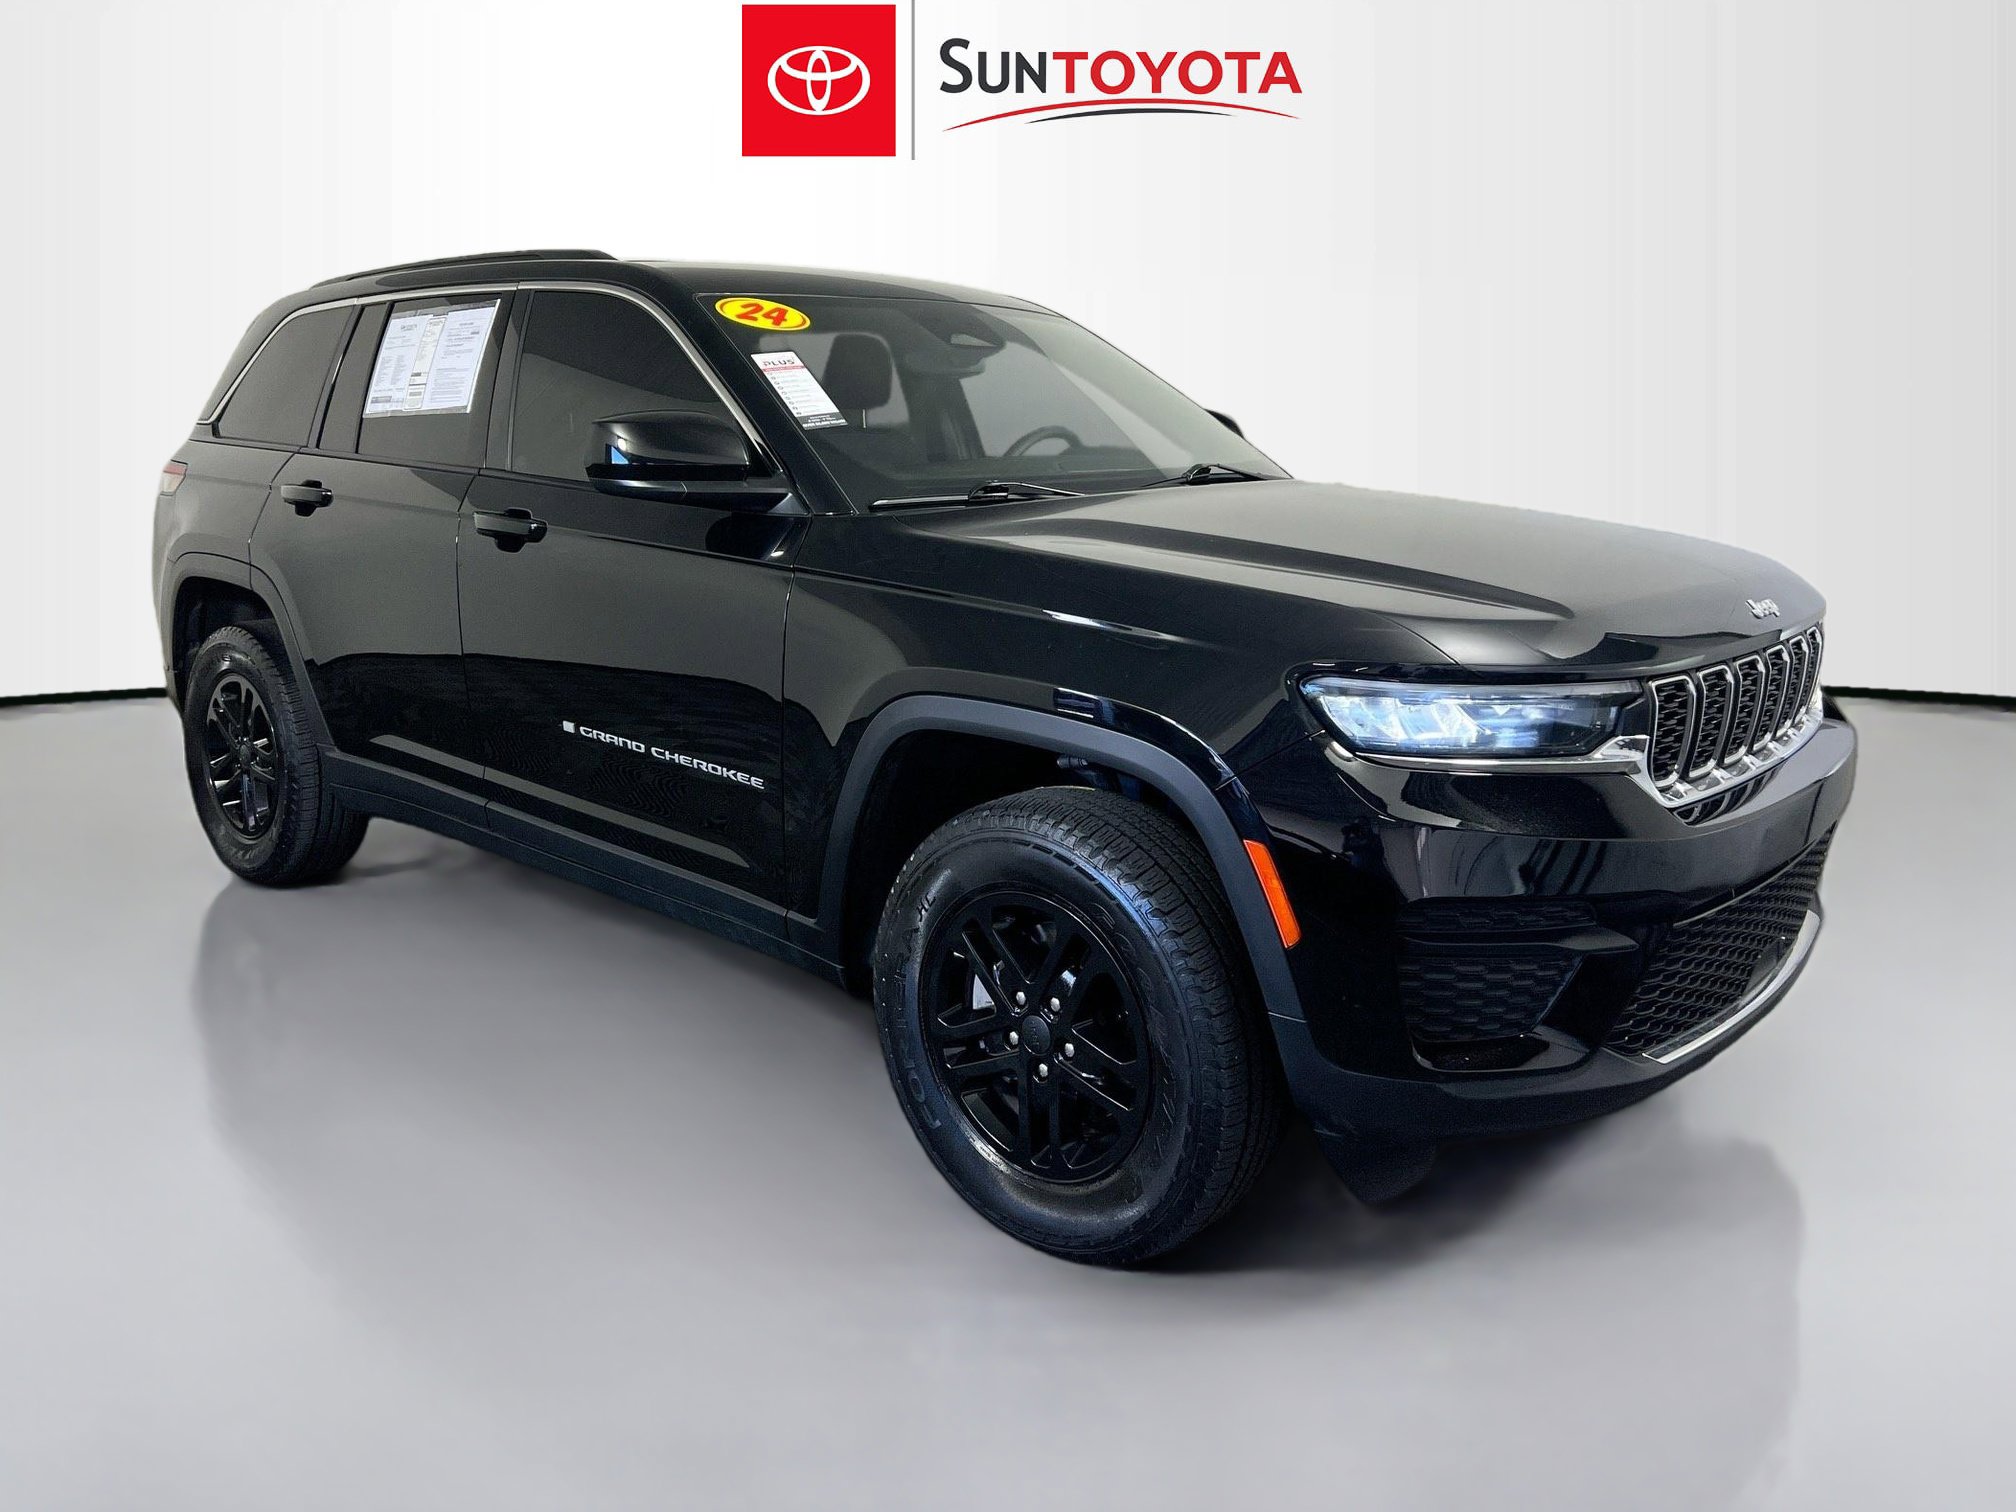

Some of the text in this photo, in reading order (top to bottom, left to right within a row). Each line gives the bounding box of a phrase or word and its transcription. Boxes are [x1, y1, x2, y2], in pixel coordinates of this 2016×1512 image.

[735, 303, 789, 327] 24
[762, 359, 796, 367] PLUS
[579, 726, 765, 790] GRAND CHEROKEE
